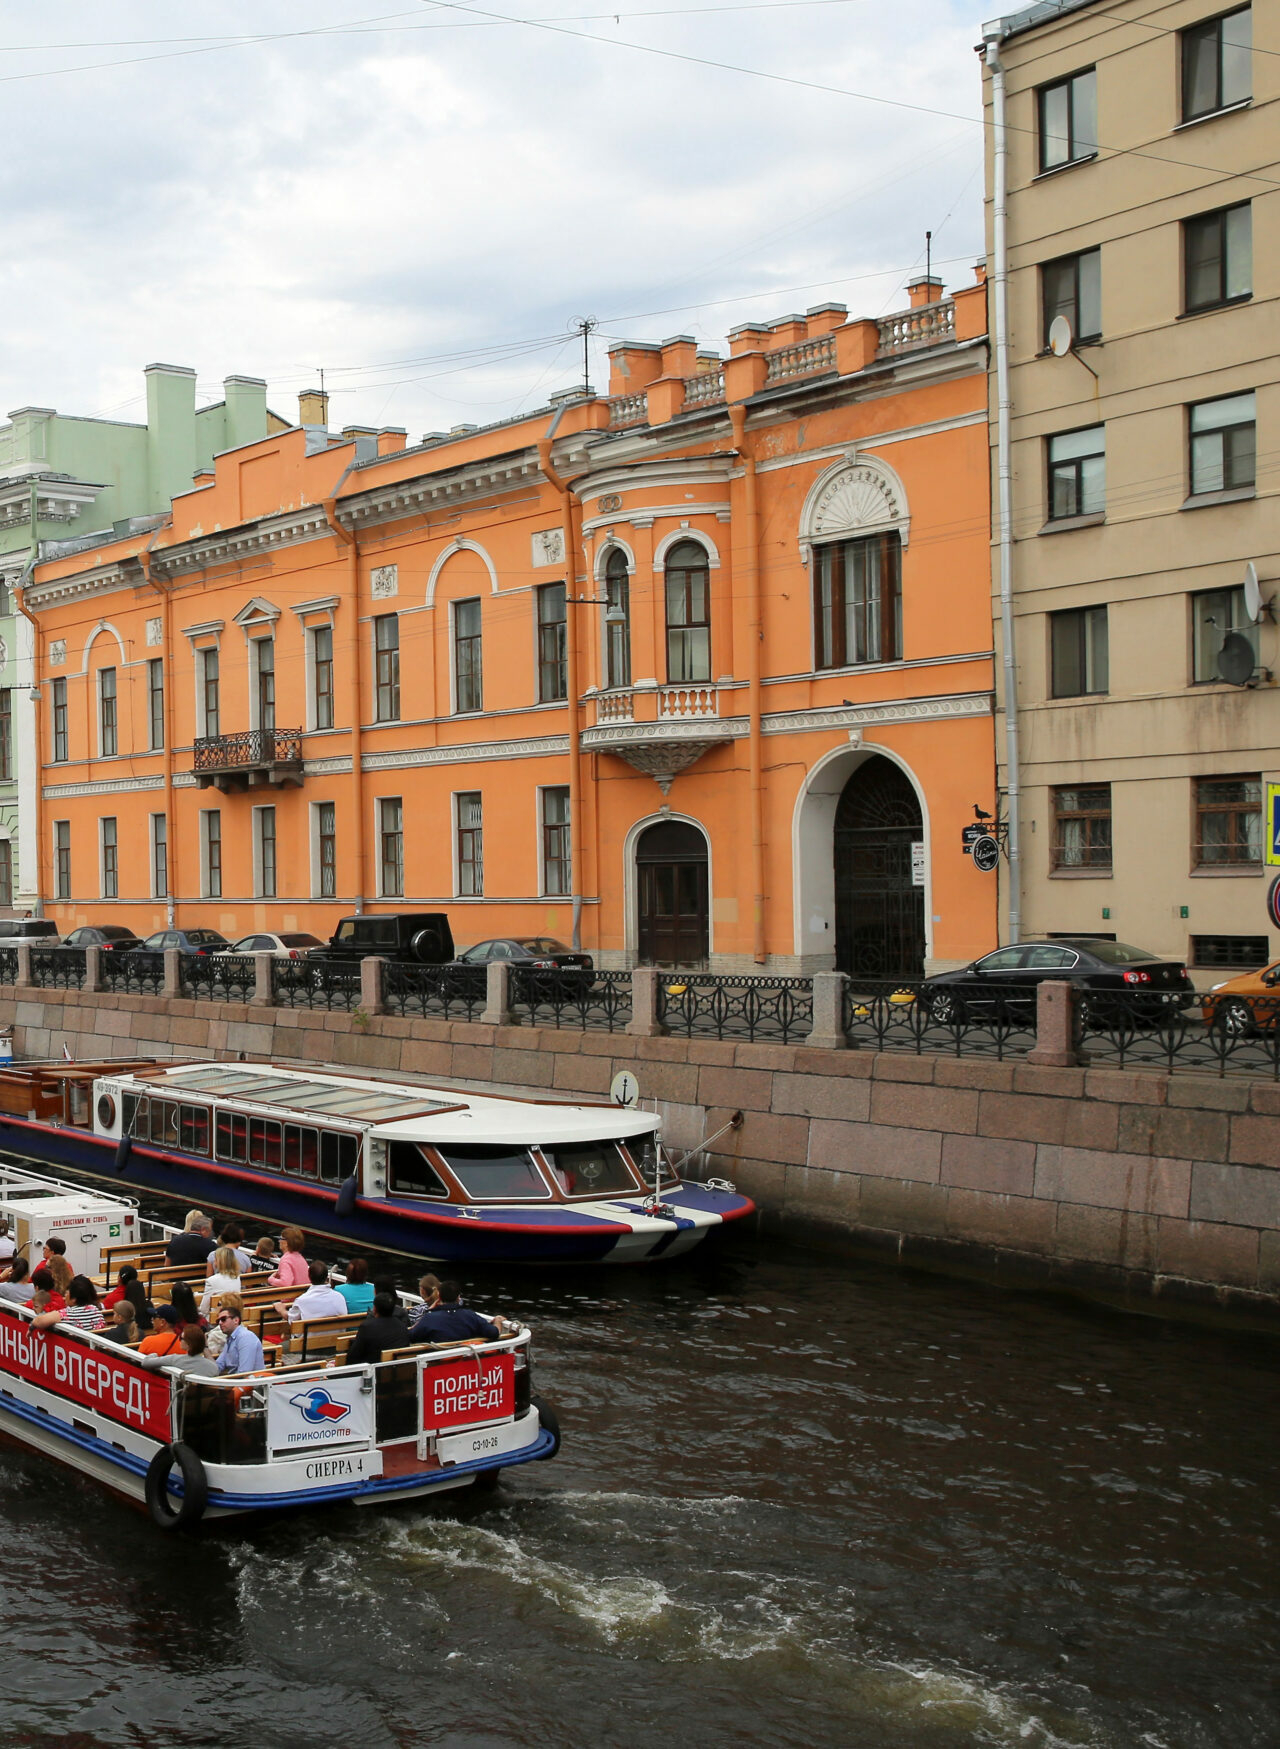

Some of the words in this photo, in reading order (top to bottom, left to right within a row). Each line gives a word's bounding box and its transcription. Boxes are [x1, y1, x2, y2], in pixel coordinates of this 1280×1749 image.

[54, 1344, 151, 1426] ВПЕРЕД!
[433, 1365, 504, 1395] ПОЛНЫЙ
[433, 1387, 504, 1416] ВПЕРЕД!
[306, 1459, 352, 1479] СИЕРРА
[357, 1458, 363, 1472] 4
